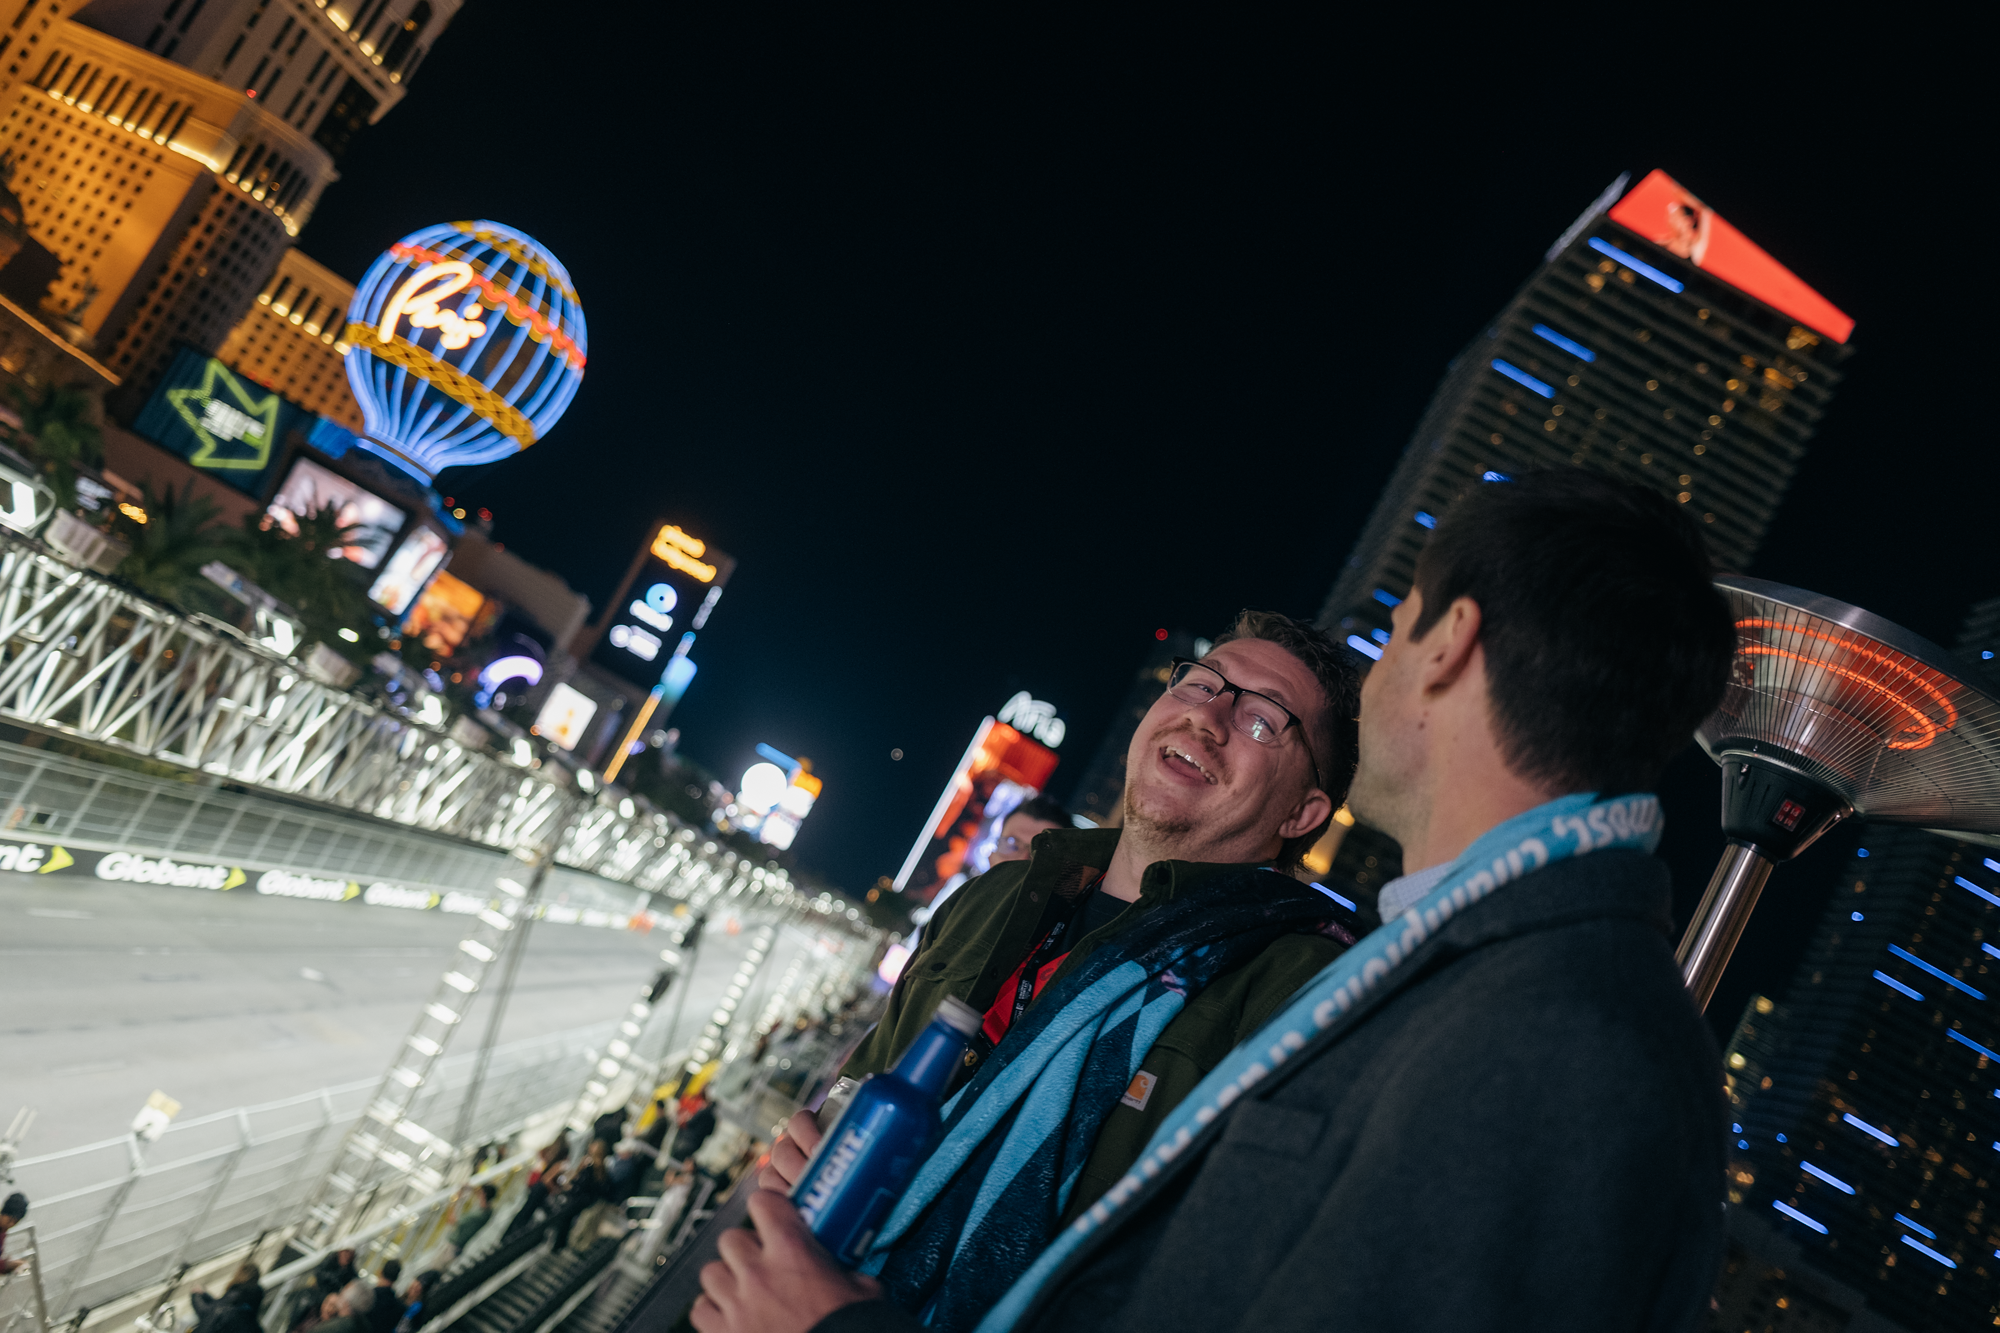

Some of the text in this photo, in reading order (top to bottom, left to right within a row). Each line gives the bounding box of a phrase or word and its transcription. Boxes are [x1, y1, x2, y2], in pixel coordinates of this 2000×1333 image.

[377, 260, 487, 350] Paris
[95, 851, 228, 890] Globant
[804, 1128, 865, 1211] LIGHT
